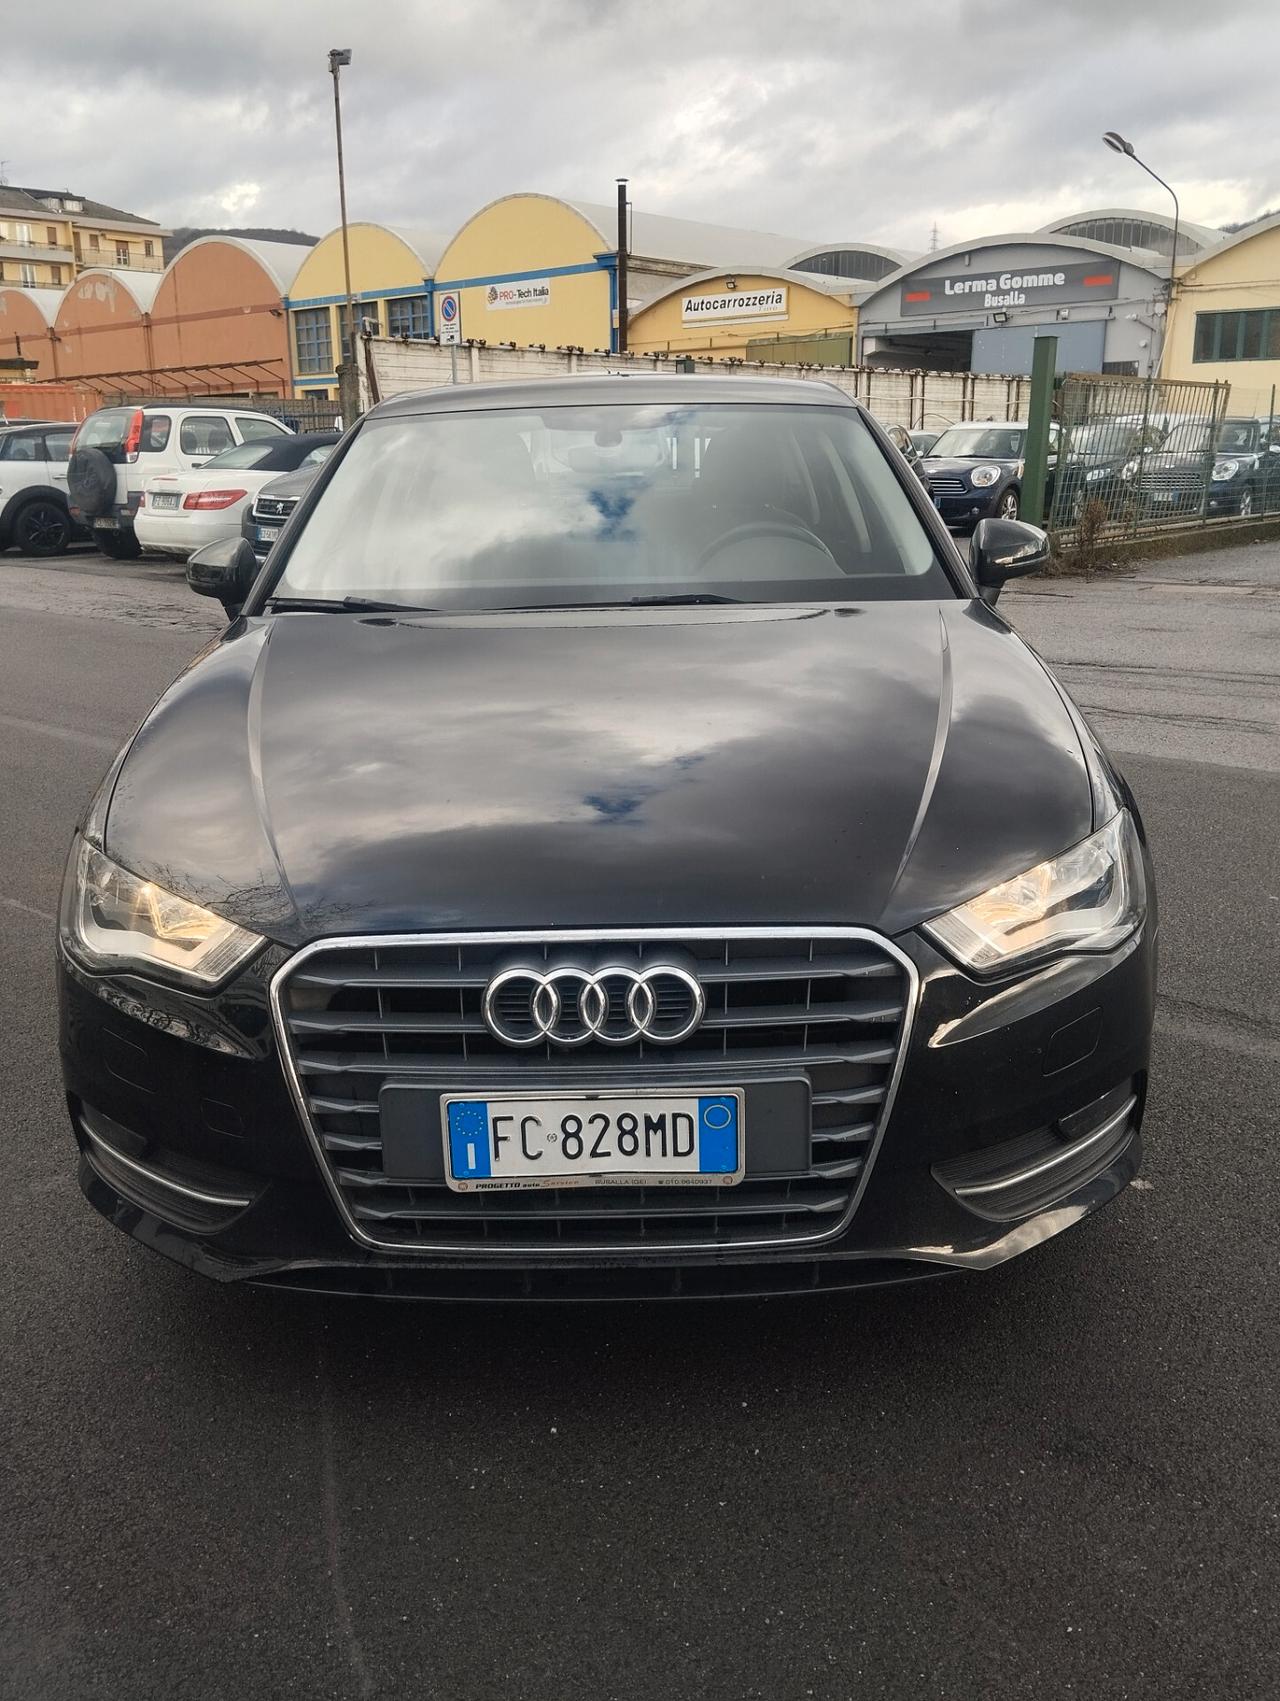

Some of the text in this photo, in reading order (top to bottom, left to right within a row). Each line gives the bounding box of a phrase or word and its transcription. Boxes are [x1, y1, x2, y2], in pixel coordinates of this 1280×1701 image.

[533, 286, 549, 296] Italia
[944, 273, 1065, 295] Lerma Gomme
[684, 291, 782, 312] Autocarrozzeria
[984, 291, 1026, 307] Busalla
